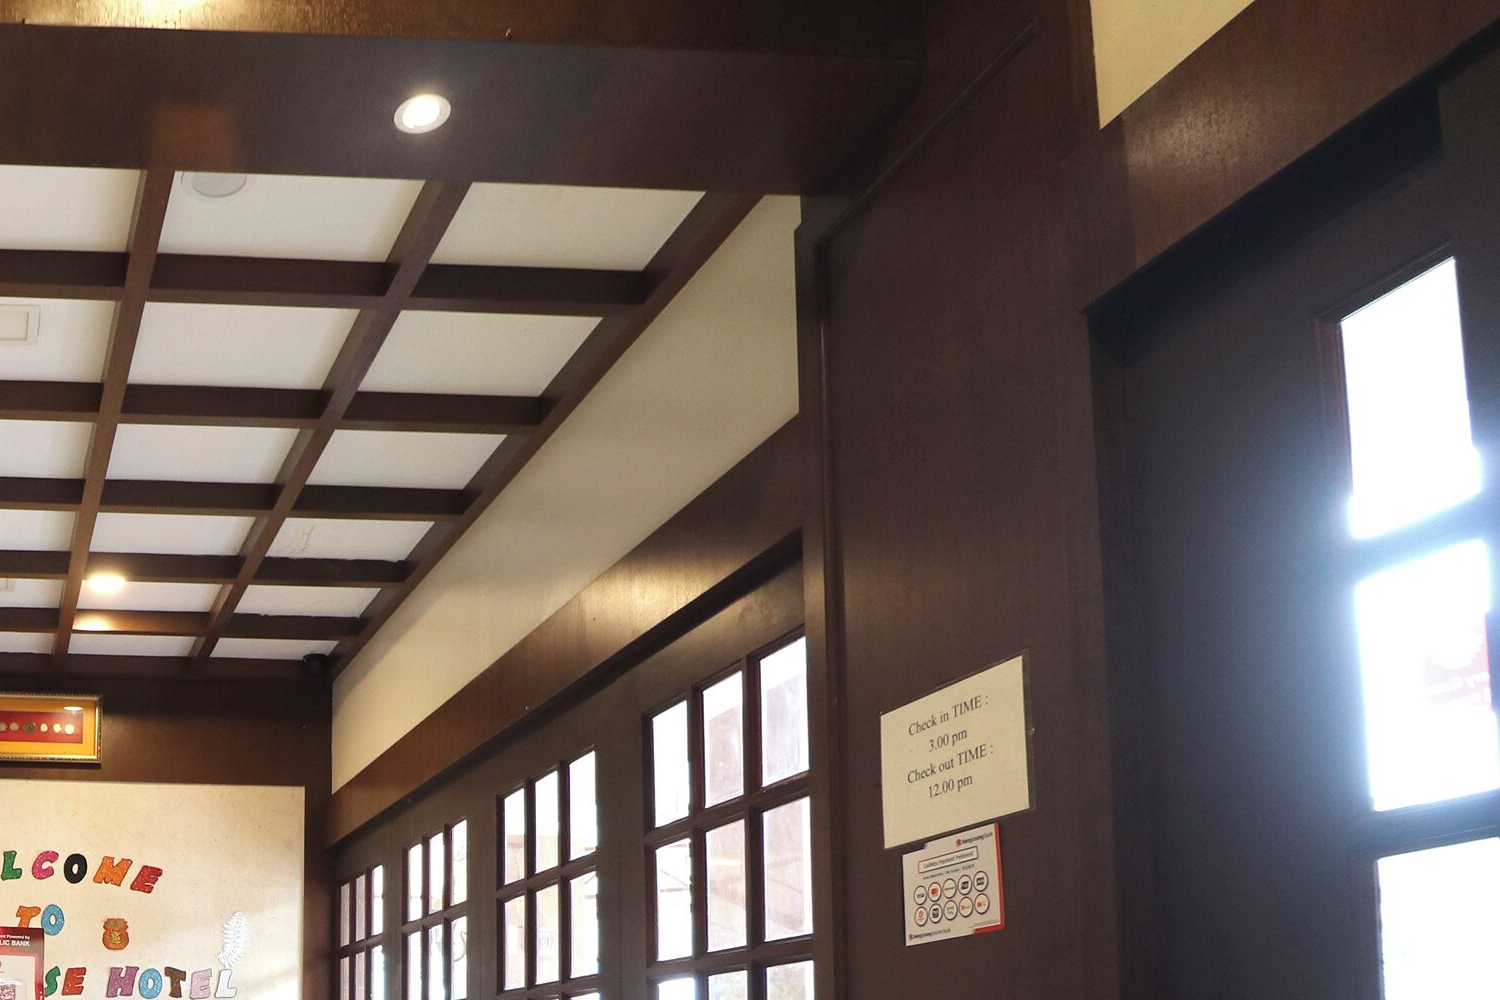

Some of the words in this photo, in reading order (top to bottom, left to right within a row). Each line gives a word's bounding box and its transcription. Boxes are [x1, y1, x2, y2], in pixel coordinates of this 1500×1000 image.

[908, 714, 938, 736] Check
[939, 711, 950, 725] in
[951, 695, 982, 719] TIME
[928, 733, 950, 753] 3.00
[951, 728, 968, 748] pm
[907, 762, 937, 784] Check
[938, 758, 955, 774] out
[956, 743, 988, 767] TIME
[928, 780, 955, 799] 12.00
[956, 774, 973, 793] pm
[15, 903, 65, 936] TO
[11, 939, 31, 947] BANK
[106, 966, 238, 1000] HOTEL
